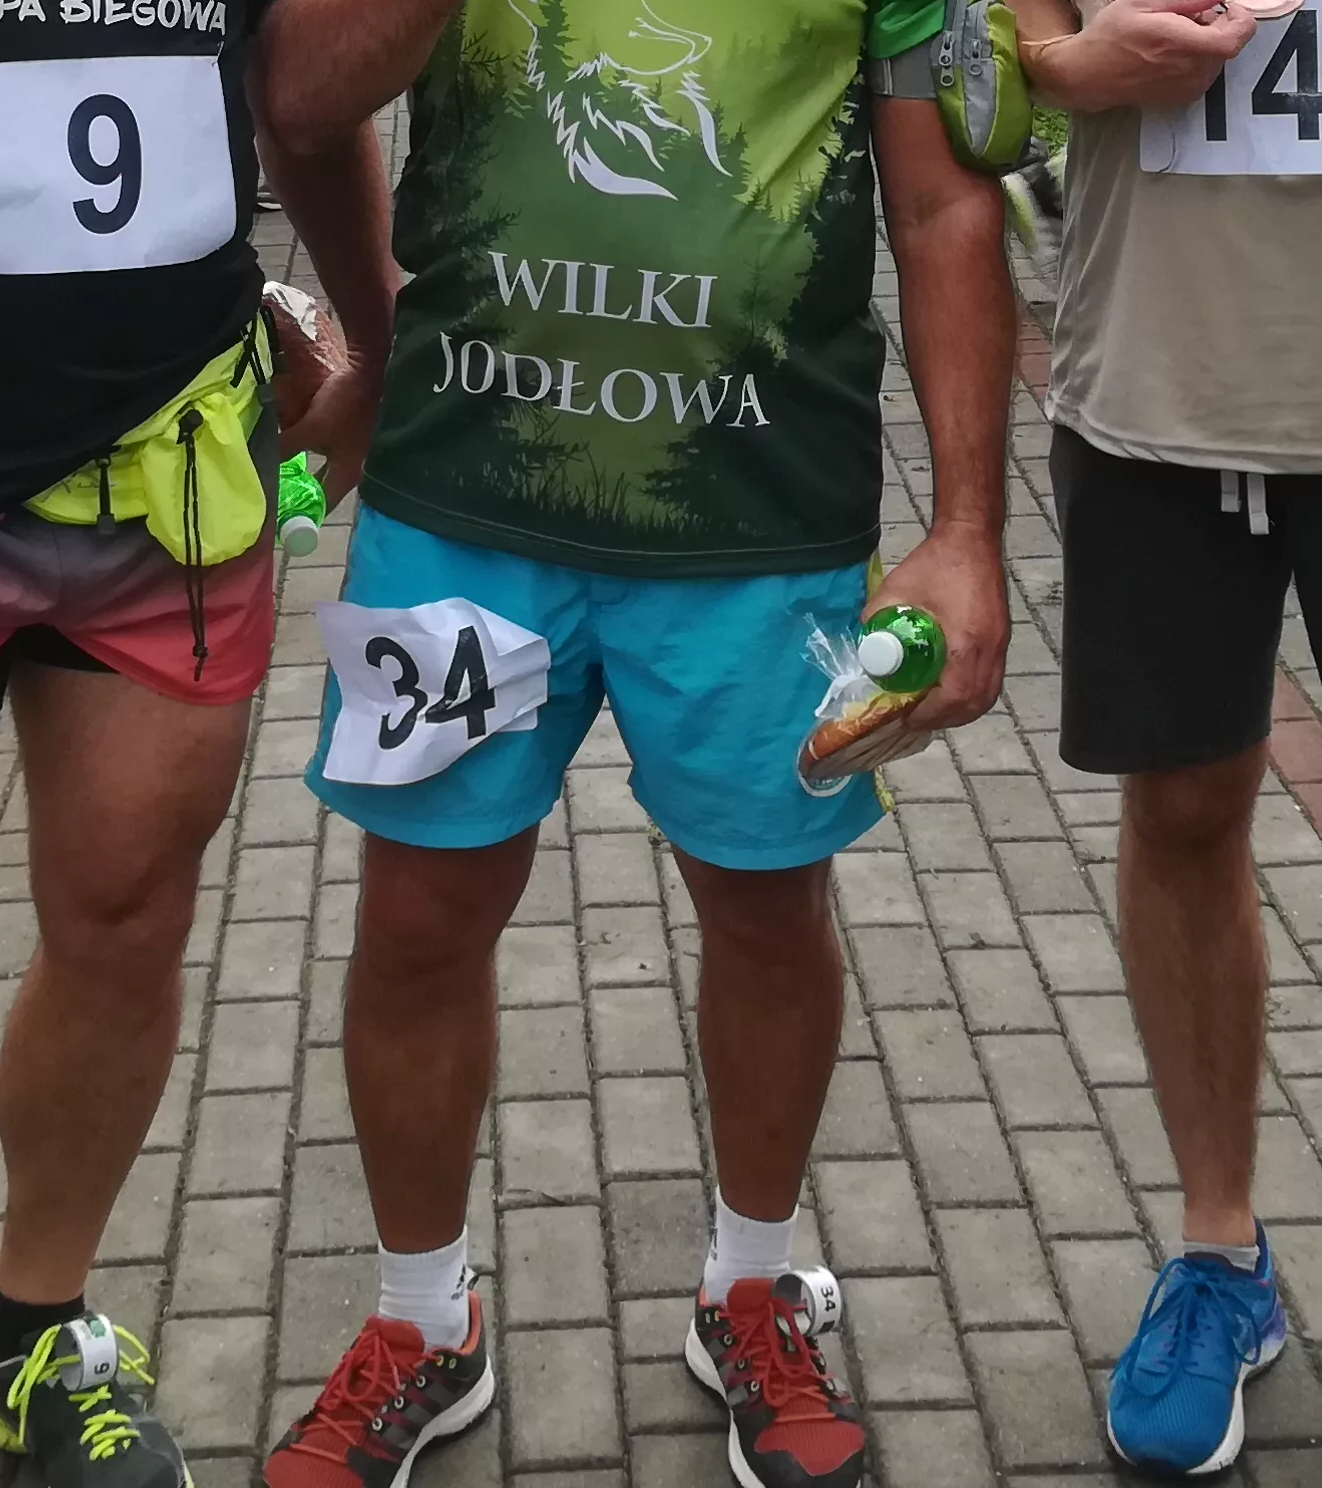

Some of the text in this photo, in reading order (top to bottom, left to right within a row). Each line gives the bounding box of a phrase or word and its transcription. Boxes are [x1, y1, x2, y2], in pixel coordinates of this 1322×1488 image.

[66, 93, 142, 236] 9
[487, 250, 718, 329] WILKI
[432, 331, 771, 429] JODŁOWA
[364, 624, 499, 751] 34
[820, 1285, 837, 1312] 34
